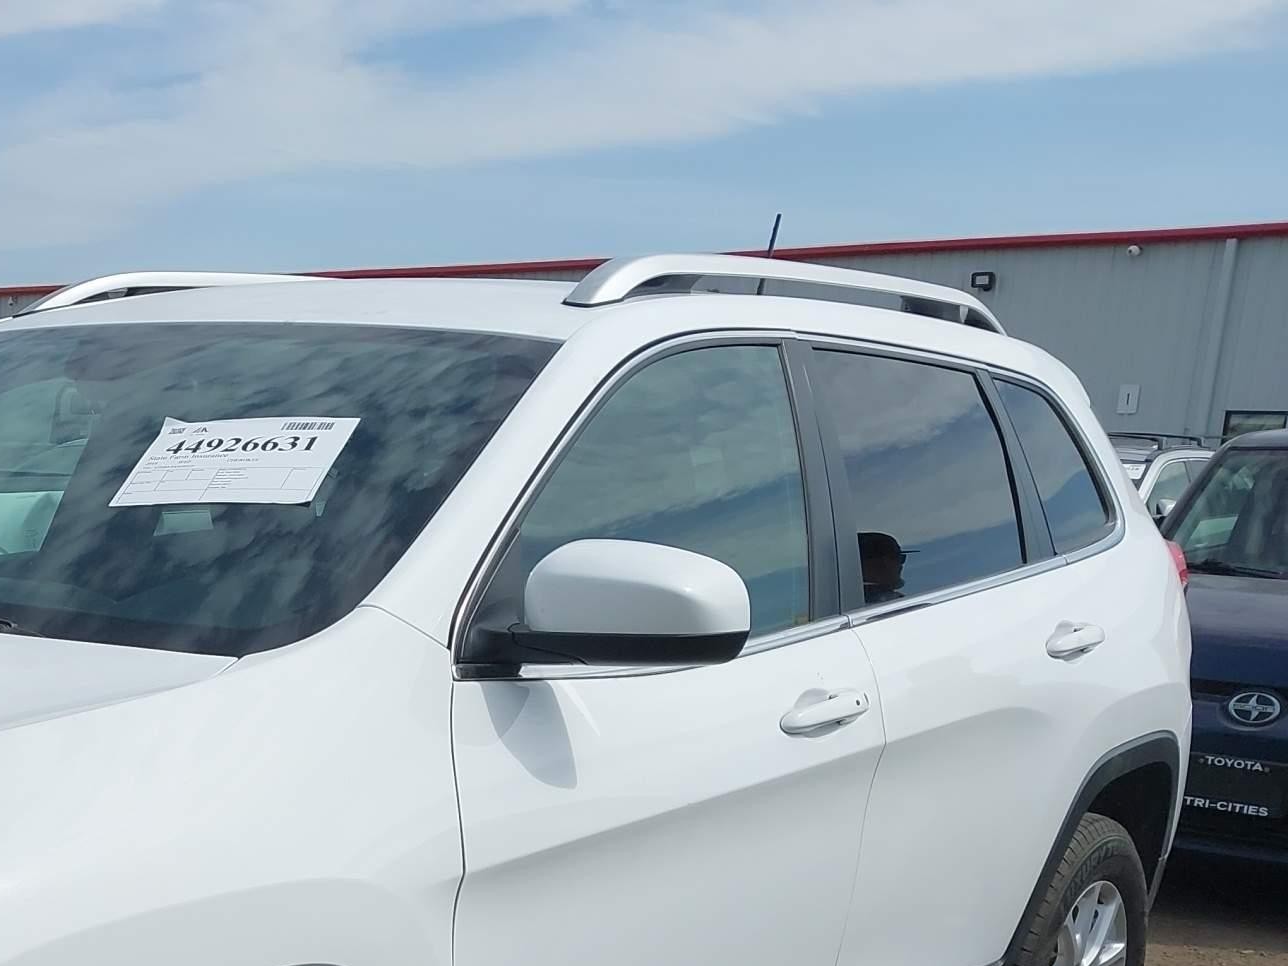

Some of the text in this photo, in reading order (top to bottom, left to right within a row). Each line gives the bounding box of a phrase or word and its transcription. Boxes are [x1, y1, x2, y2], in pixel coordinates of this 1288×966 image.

[165, 435, 318, 455] 44926631
[1205, 755, 1263, 772] TOYOTA
[1184, 795, 1269, 817] TRI-CITIES
